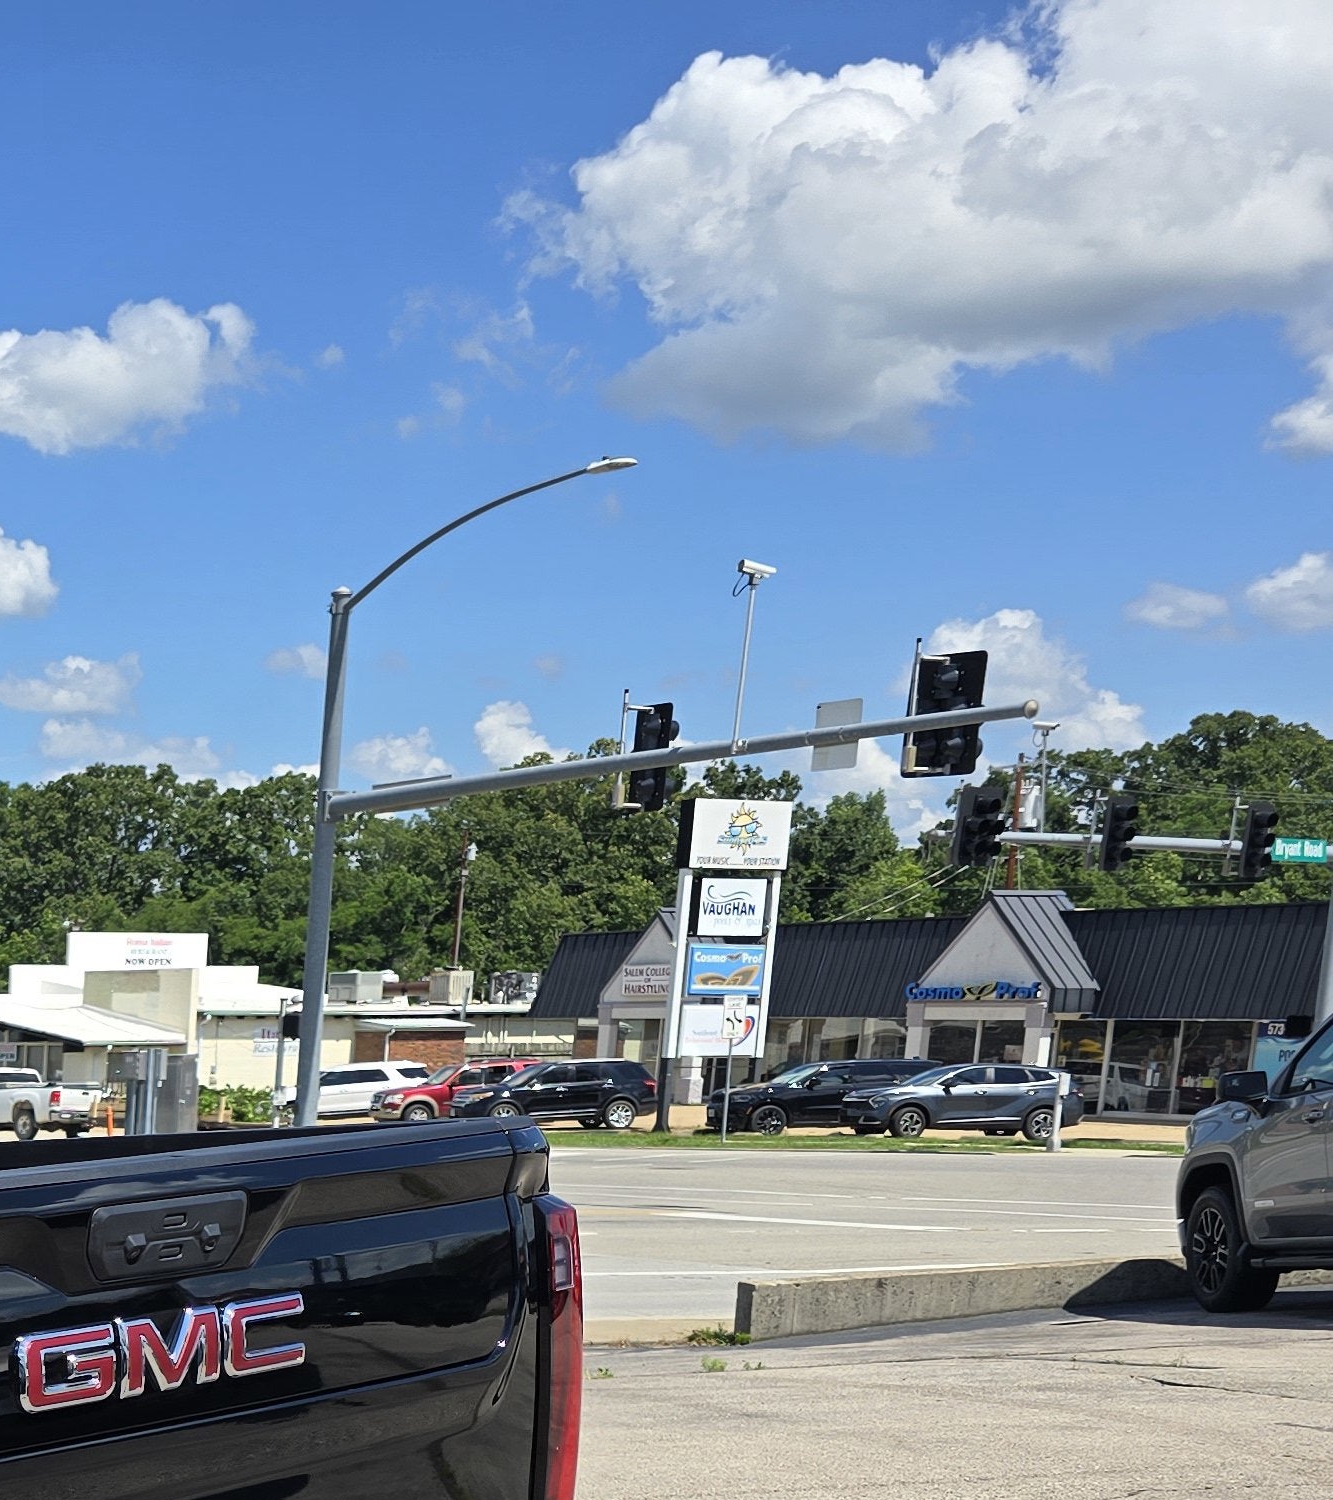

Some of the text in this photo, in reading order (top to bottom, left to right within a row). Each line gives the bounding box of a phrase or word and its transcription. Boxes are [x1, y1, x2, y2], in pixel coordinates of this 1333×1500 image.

[1275, 839, 1323, 859] Bryant Road
[703, 901, 756, 916] VAUGHAN
[694, 951, 763, 964] Cosmo Prof
[624, 966, 671, 977] SALEM COLLEG
[904, 981, 1042, 1000] Cosmo Prof
[1267, 1023, 1285, 1035] 573
[15, 1290, 306, 1414] GMC
